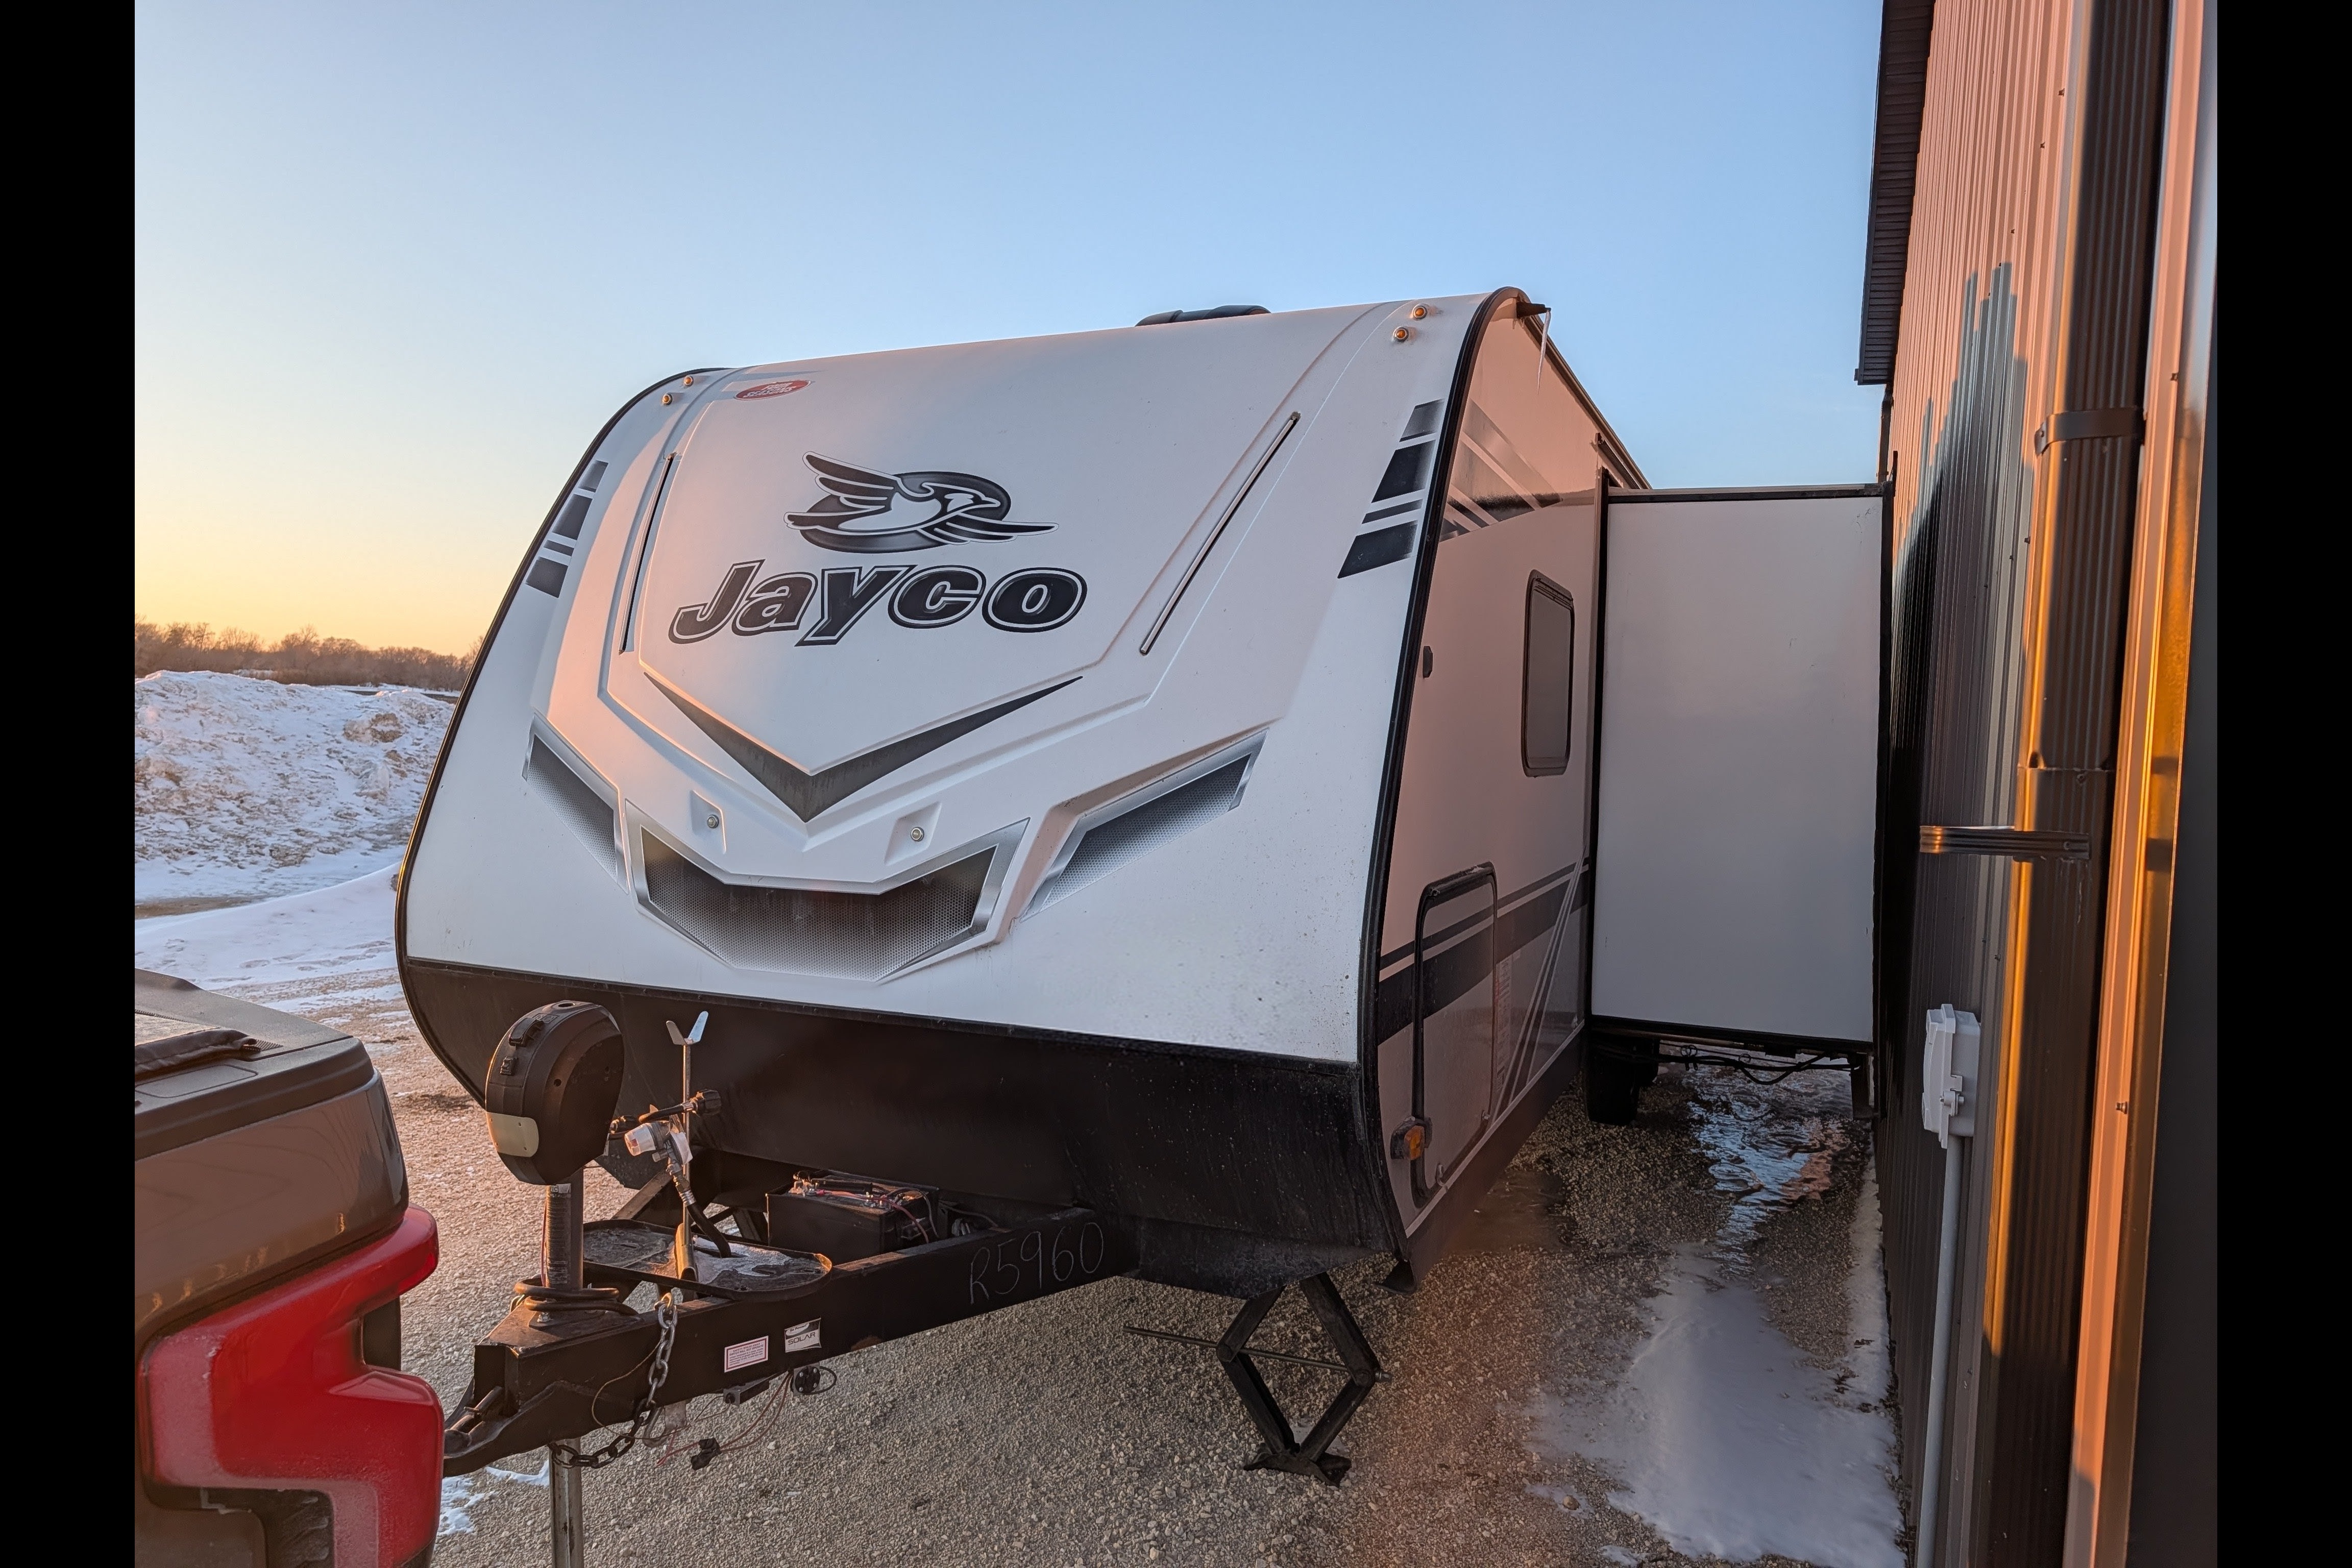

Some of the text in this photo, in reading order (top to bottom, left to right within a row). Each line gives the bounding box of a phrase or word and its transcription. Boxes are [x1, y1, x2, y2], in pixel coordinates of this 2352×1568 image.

[668, 559, 1088, 647] Jayco
[970, 1222, 1104, 1305] R5960
[788, 1332, 815, 1345] SOLAR
